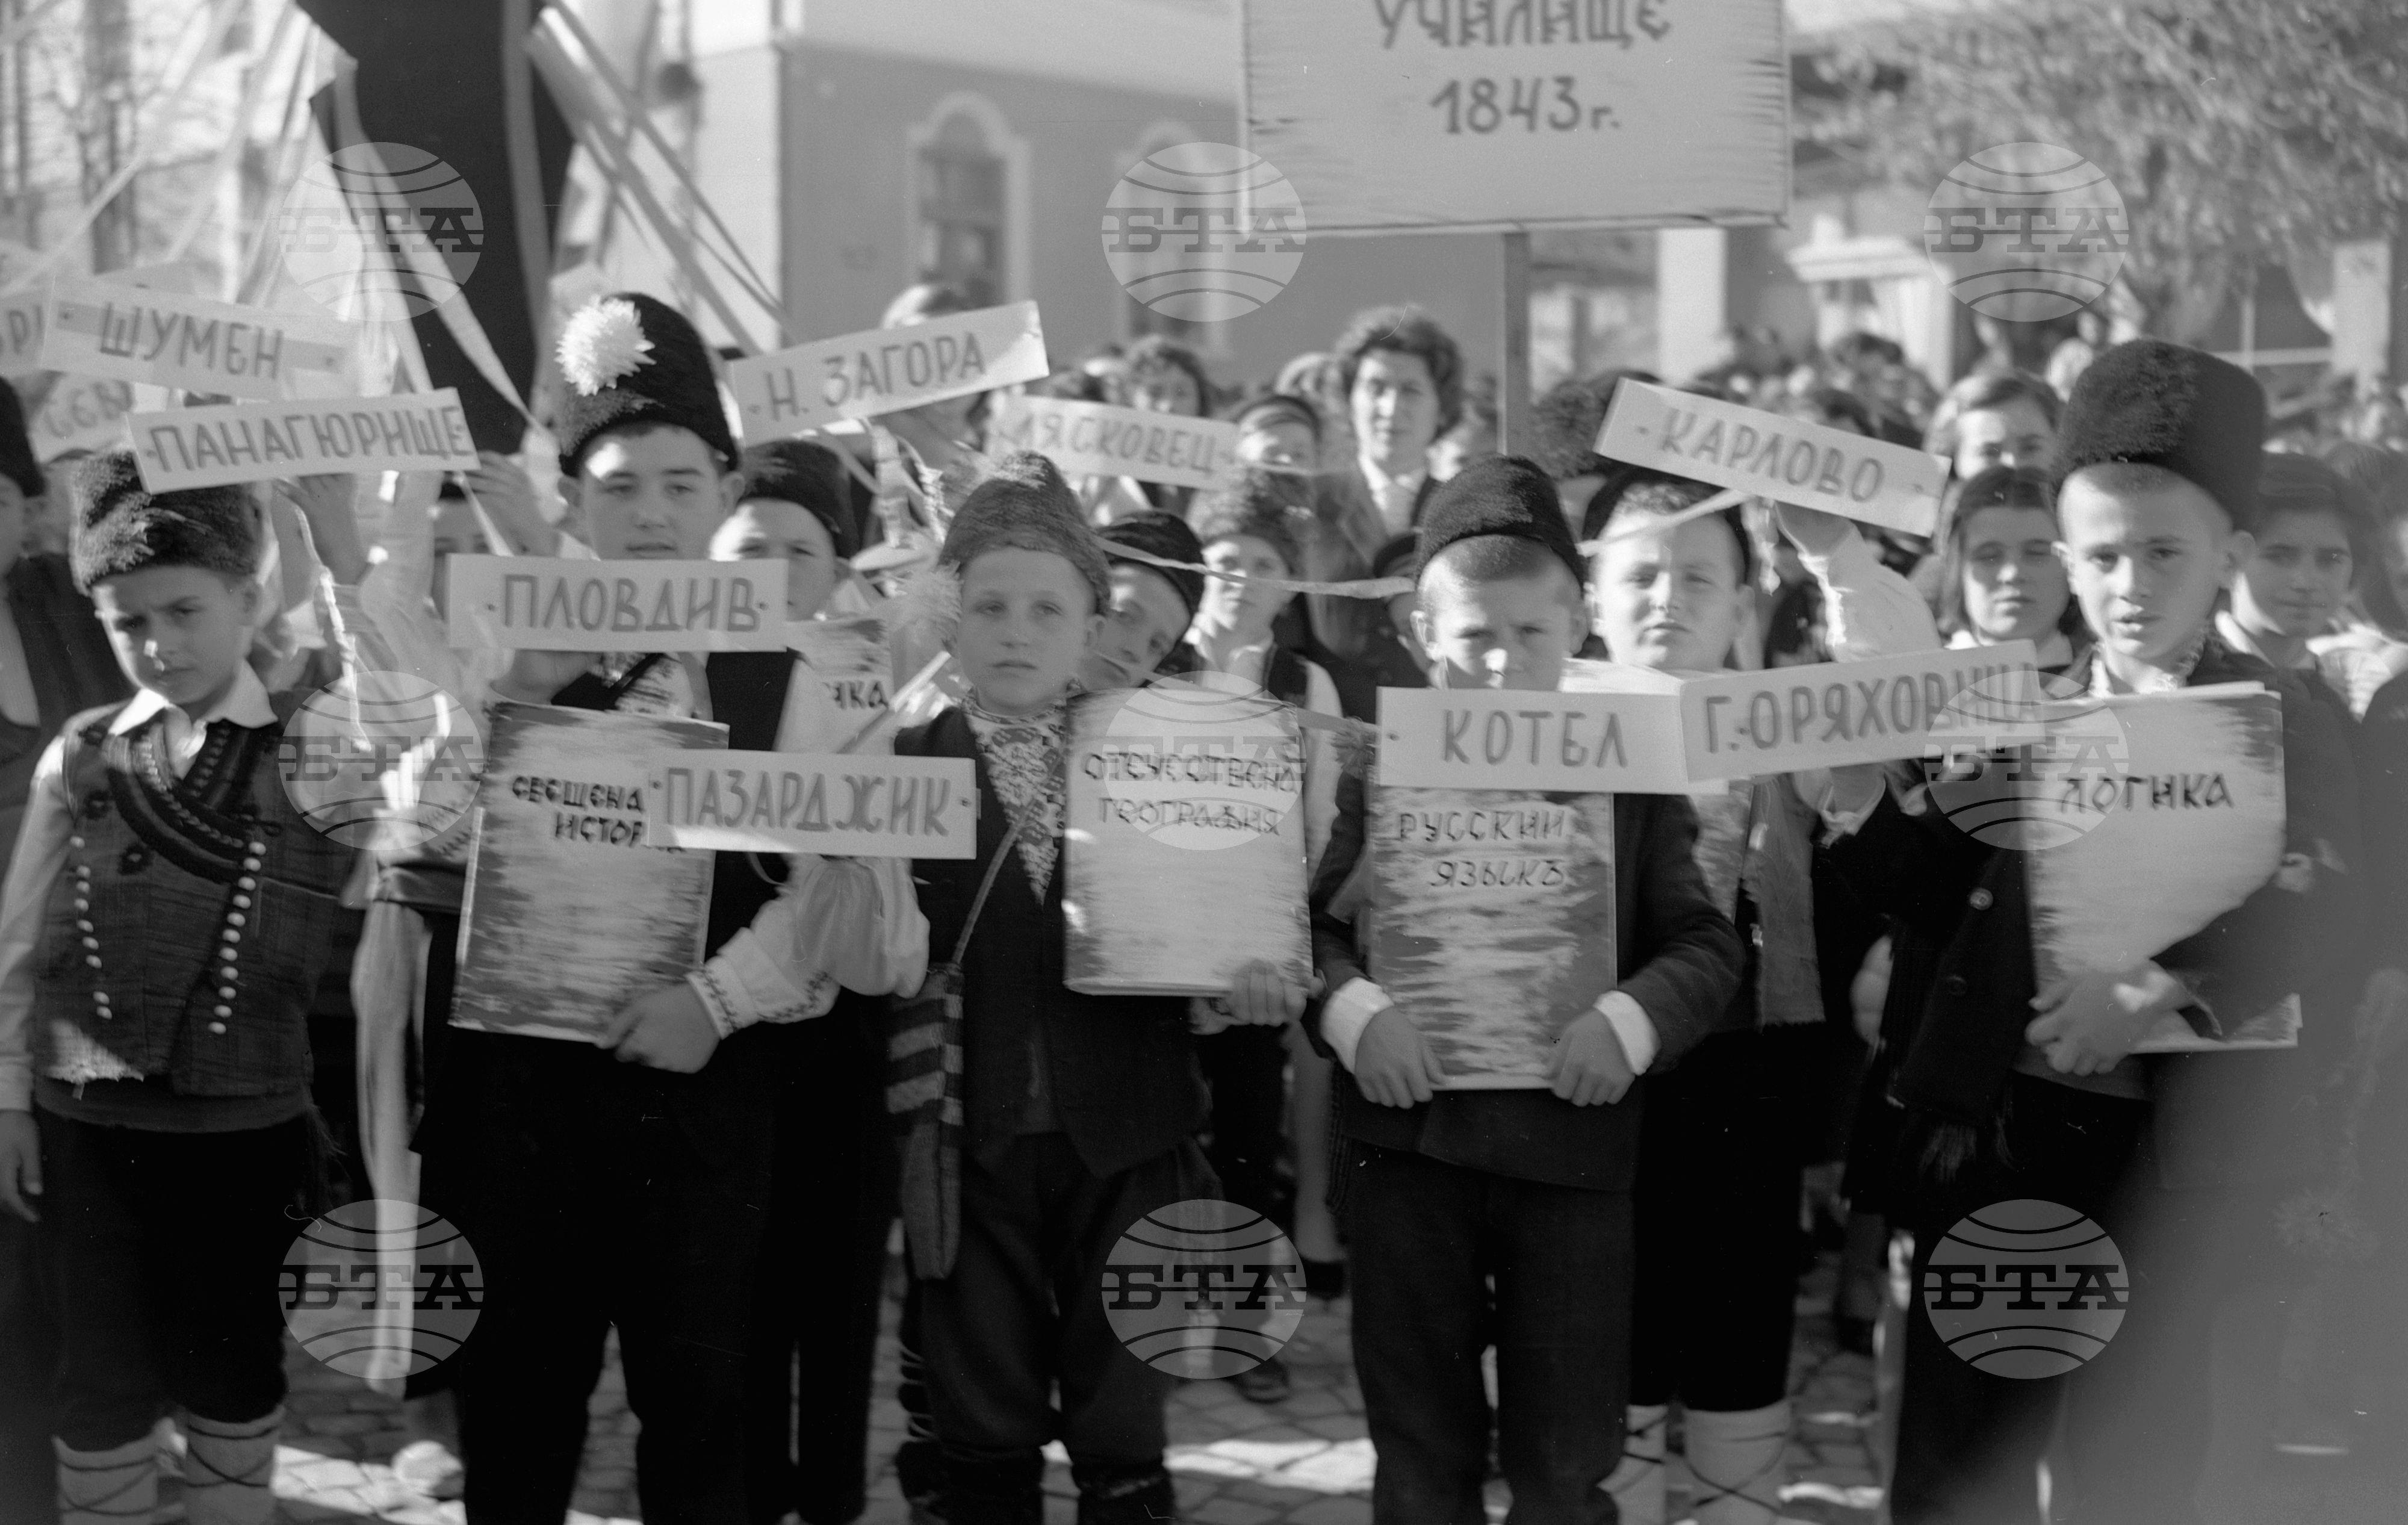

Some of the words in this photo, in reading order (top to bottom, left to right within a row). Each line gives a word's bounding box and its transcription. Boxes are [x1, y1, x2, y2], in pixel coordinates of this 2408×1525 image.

[100, 302, 283, 380] ШУМЕН
[823, 332, 985, 407] ЗАГОРА
[150, 406, 473, 472] ПАНАГЮРИЩЕ
[1660, 407, 1885, 503] КАРЛОВО
[503, 574, 761, 632] ПЛОВДИВ
[666, 768, 951, 837] ПАЗАРДЖИК
[2059, 773, 2235, 814] ЛОГИКА
